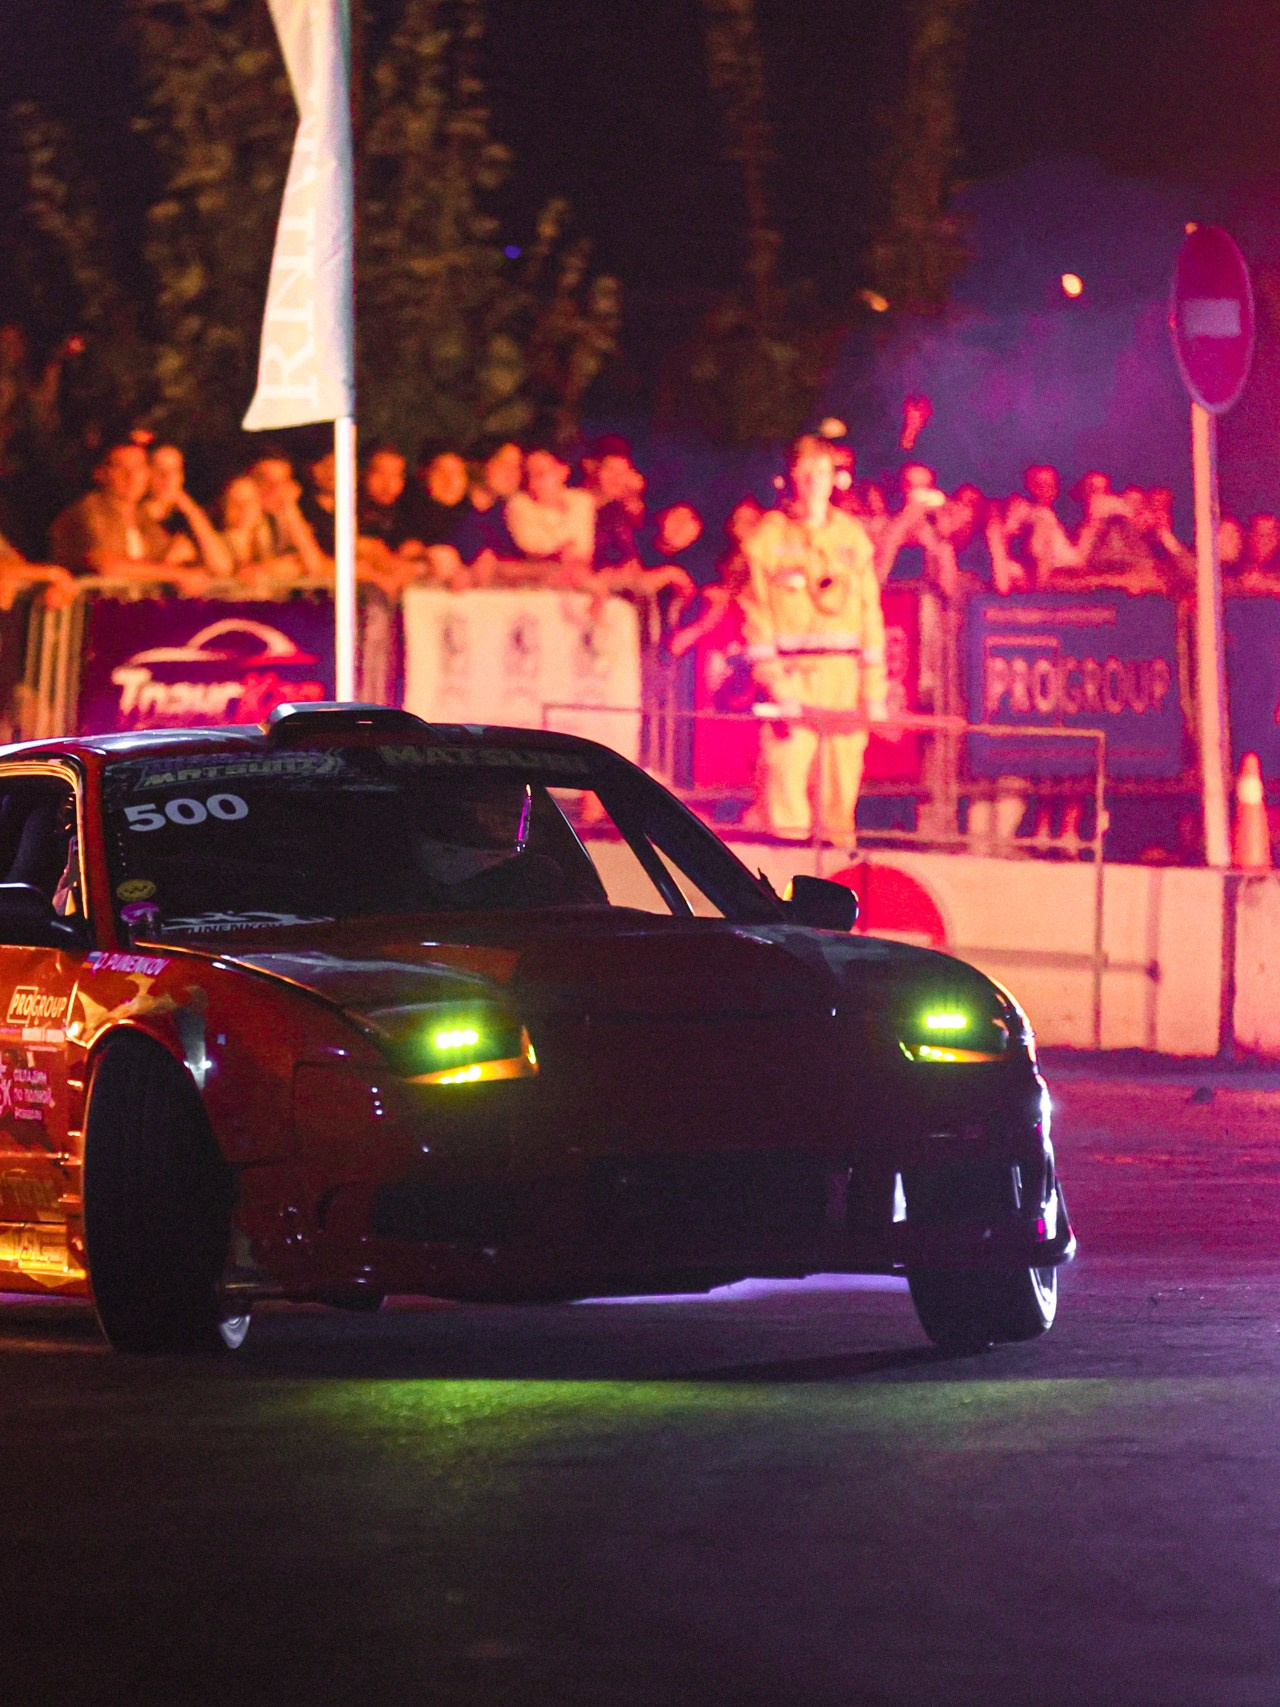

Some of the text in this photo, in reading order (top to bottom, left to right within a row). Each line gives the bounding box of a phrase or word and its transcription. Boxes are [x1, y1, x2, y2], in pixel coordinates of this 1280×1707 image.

[984, 655, 1170, 714] PROGROUP
[123, 793, 250, 833] 500
[9, 993, 68, 1019] PROGROUP
